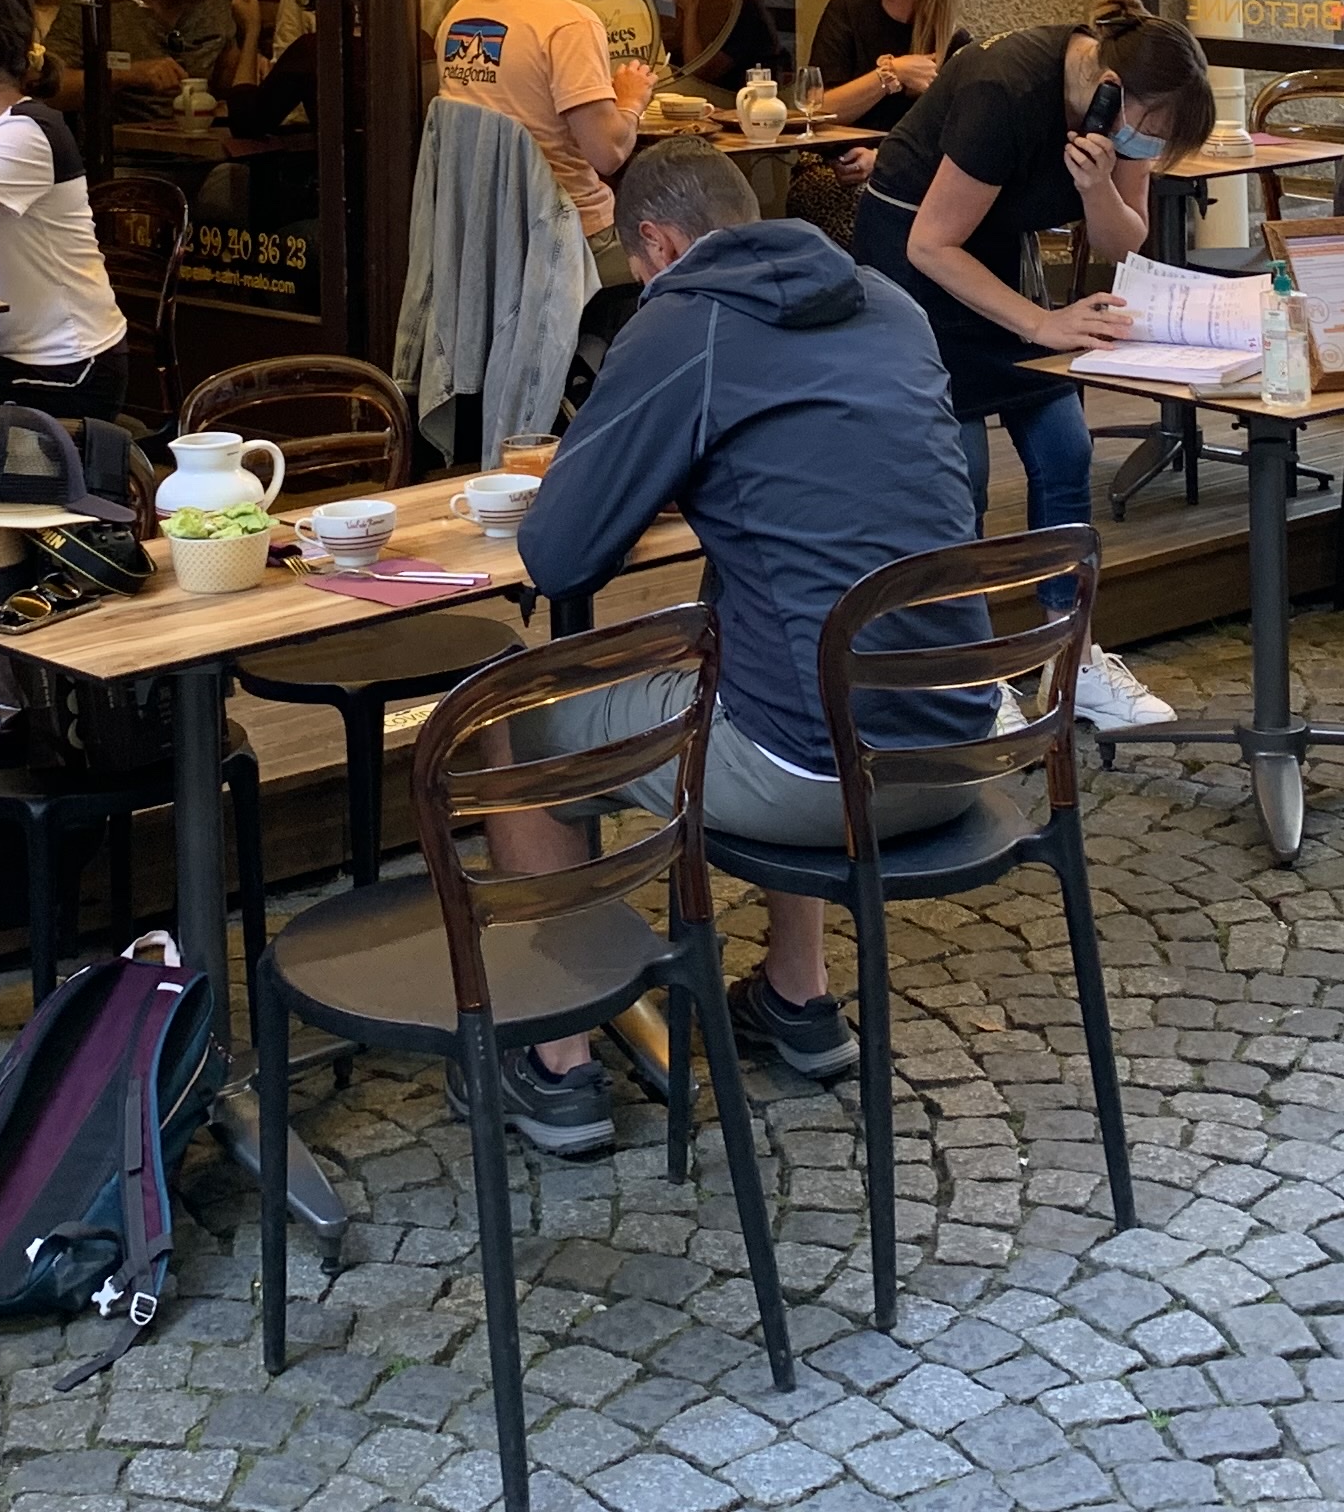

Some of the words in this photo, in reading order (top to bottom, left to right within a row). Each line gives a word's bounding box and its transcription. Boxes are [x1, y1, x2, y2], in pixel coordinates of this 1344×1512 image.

[443, 65, 497, 86] patagonia
[199, 225, 222, 257] 99
[227, 227, 253, 261] 40
[258, 232, 281, 265] 36
[285, 235, 307, 270] 23
[37, 528, 67, 550] NIK
